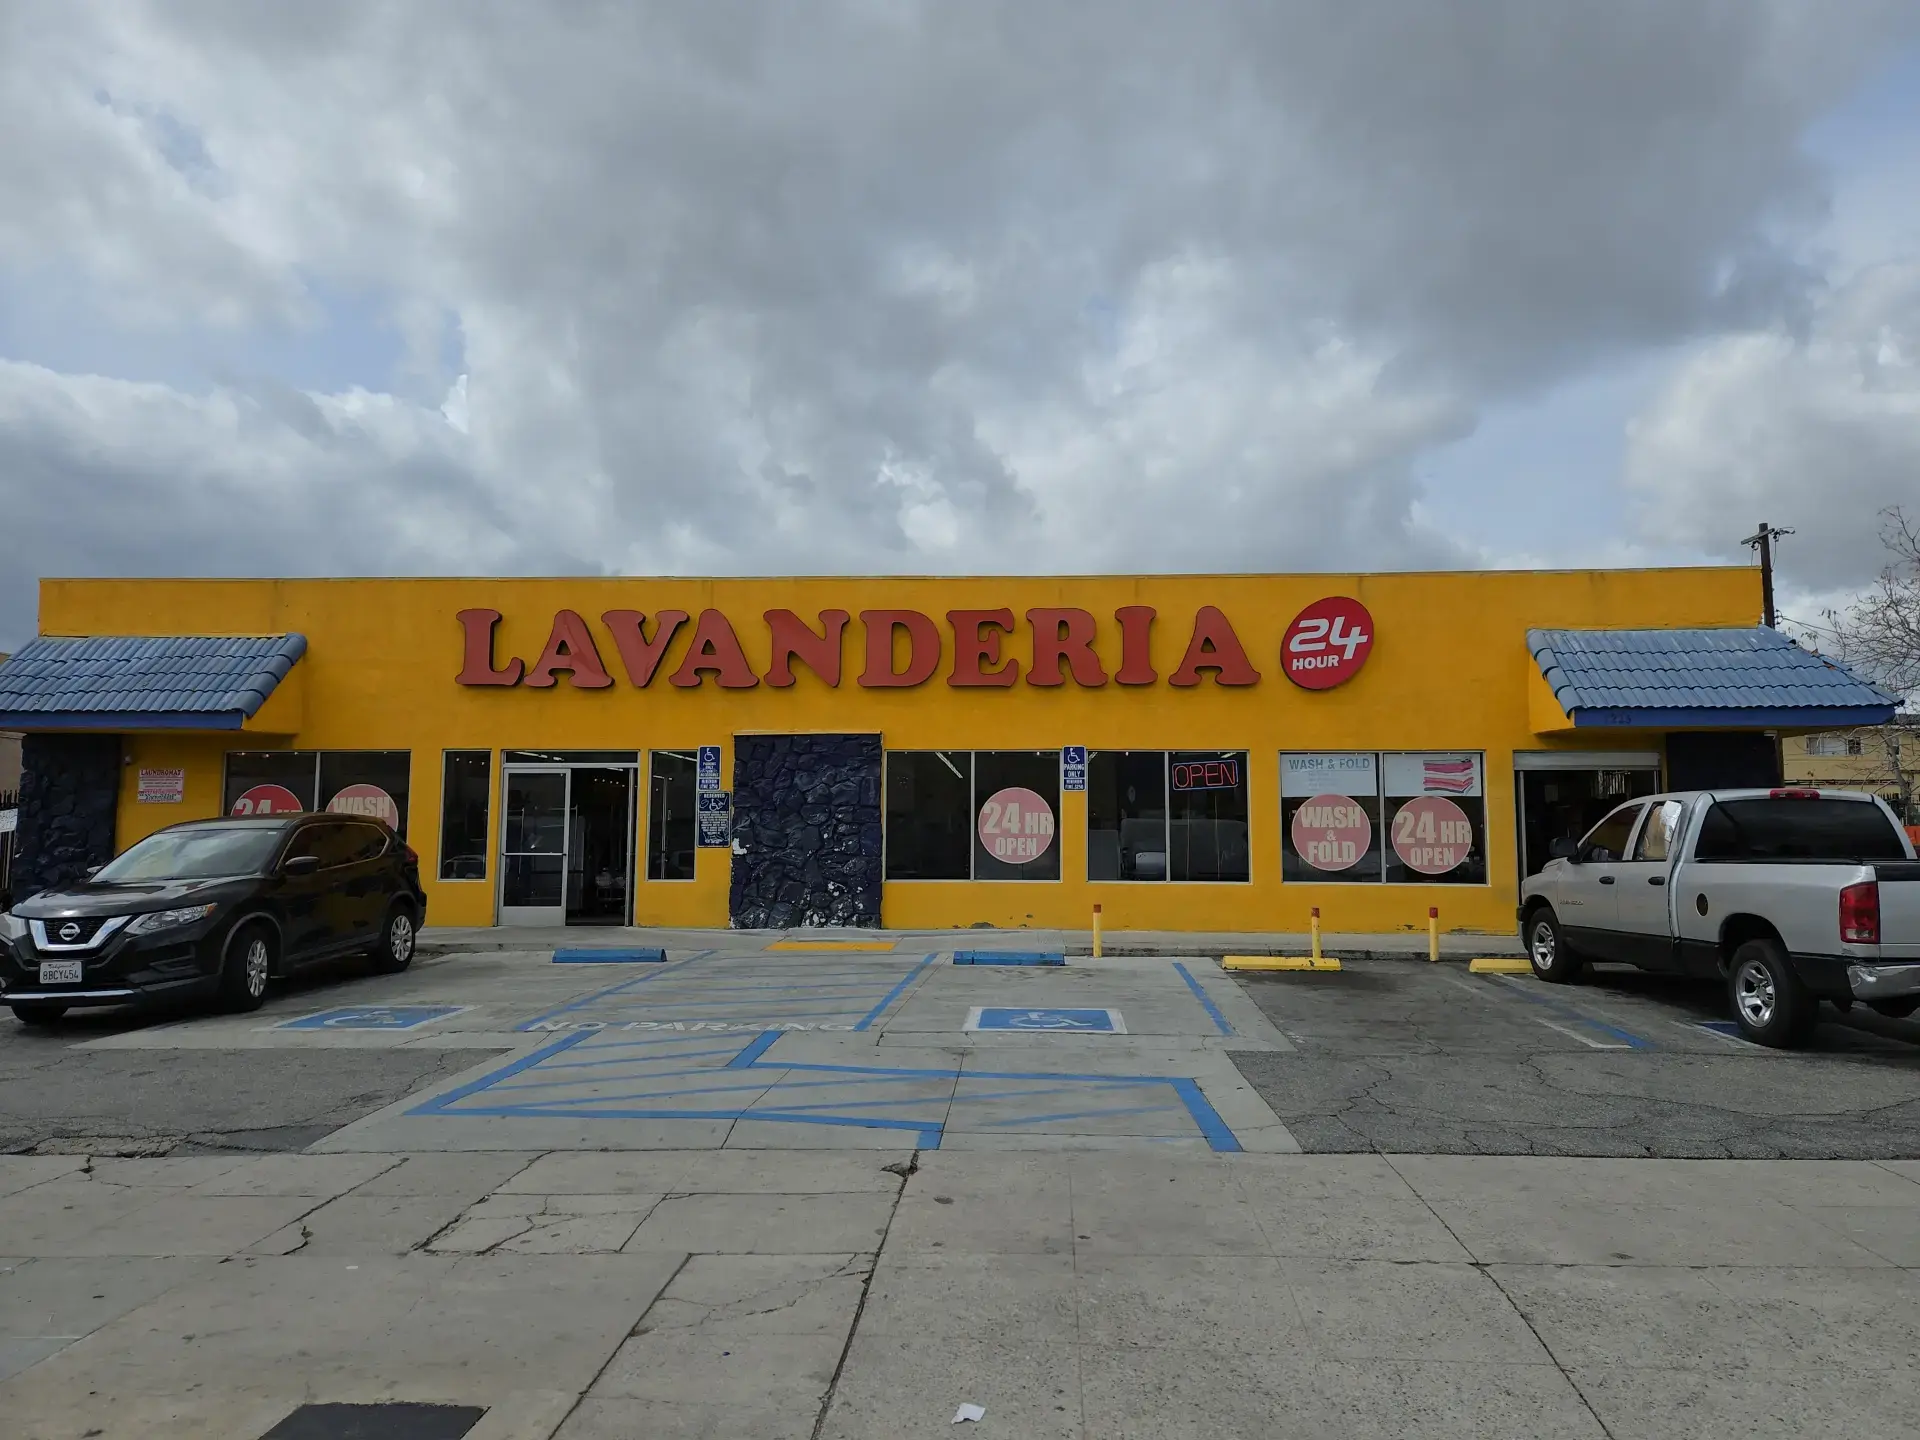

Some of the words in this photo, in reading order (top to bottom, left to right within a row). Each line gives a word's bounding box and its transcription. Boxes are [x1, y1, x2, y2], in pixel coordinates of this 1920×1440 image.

[455, 605, 1262, 689] LAVANDERIA
[1289, 616, 1369, 660] 24
[1292, 655, 1339, 671] HOUR
[1067, 770, 1081, 778] ONLY
[1289, 759, 1323, 770] WASH
[1328, 758, 1336, 769] &
[1339, 758, 1370, 769] FOLD
[1174, 762, 1236, 788] OPEN
[333, 796, 390, 818] WASH
[1301, 806, 1361, 828] WASH
[983, 801, 1021, 834] 24
[1025, 812, 1054, 835] HR
[1395, 811, 1437, 844] 24
[1441, 821, 1472, 845] HR
[1326, 829, 1337, 841] &
[995, 837, 1037, 856] OPEN
[1307, 841, 1356, 863] FOLD
[1410, 848, 1455, 866] OPEN
[42, 969, 79, 981] 8BCY454
[525, 1021, 608, 1032] NO
[620, 1020, 857, 1032] PARKING
